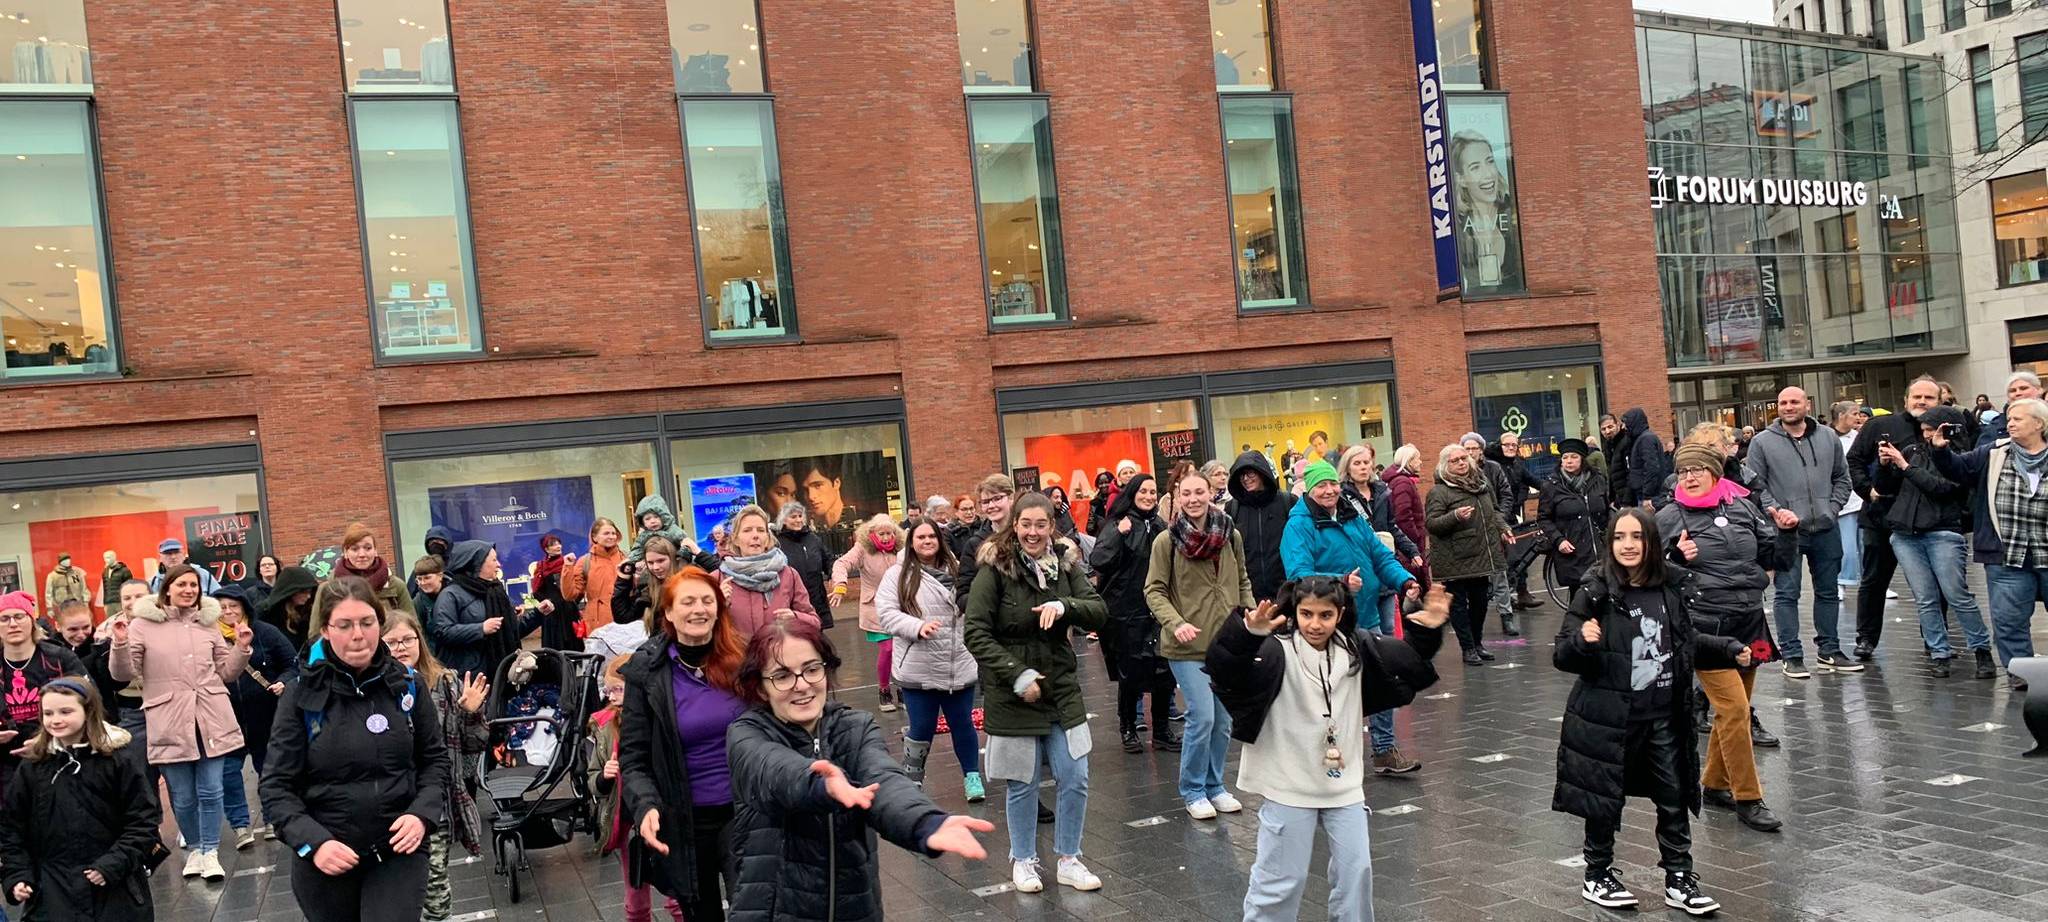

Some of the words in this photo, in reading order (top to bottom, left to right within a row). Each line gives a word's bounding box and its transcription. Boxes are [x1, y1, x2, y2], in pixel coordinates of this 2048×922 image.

[1777, 104, 1809, 122] ADI
[1420, 63, 1451, 239] KARSTADT
[1677, 175, 1759, 205] FORUM
[1762, 177, 1868, 207] DUISBURG
[1159, 431, 1193, 448] FINAL
[1163, 445, 1192, 458] SALE
[200, 516, 249, 536] FINAL
[482, 514, 516, 523] Villeroy
[525, 511, 547, 520] Boch
[204, 531, 247, 548] SALE
[209, 560, 247, 583] 70
